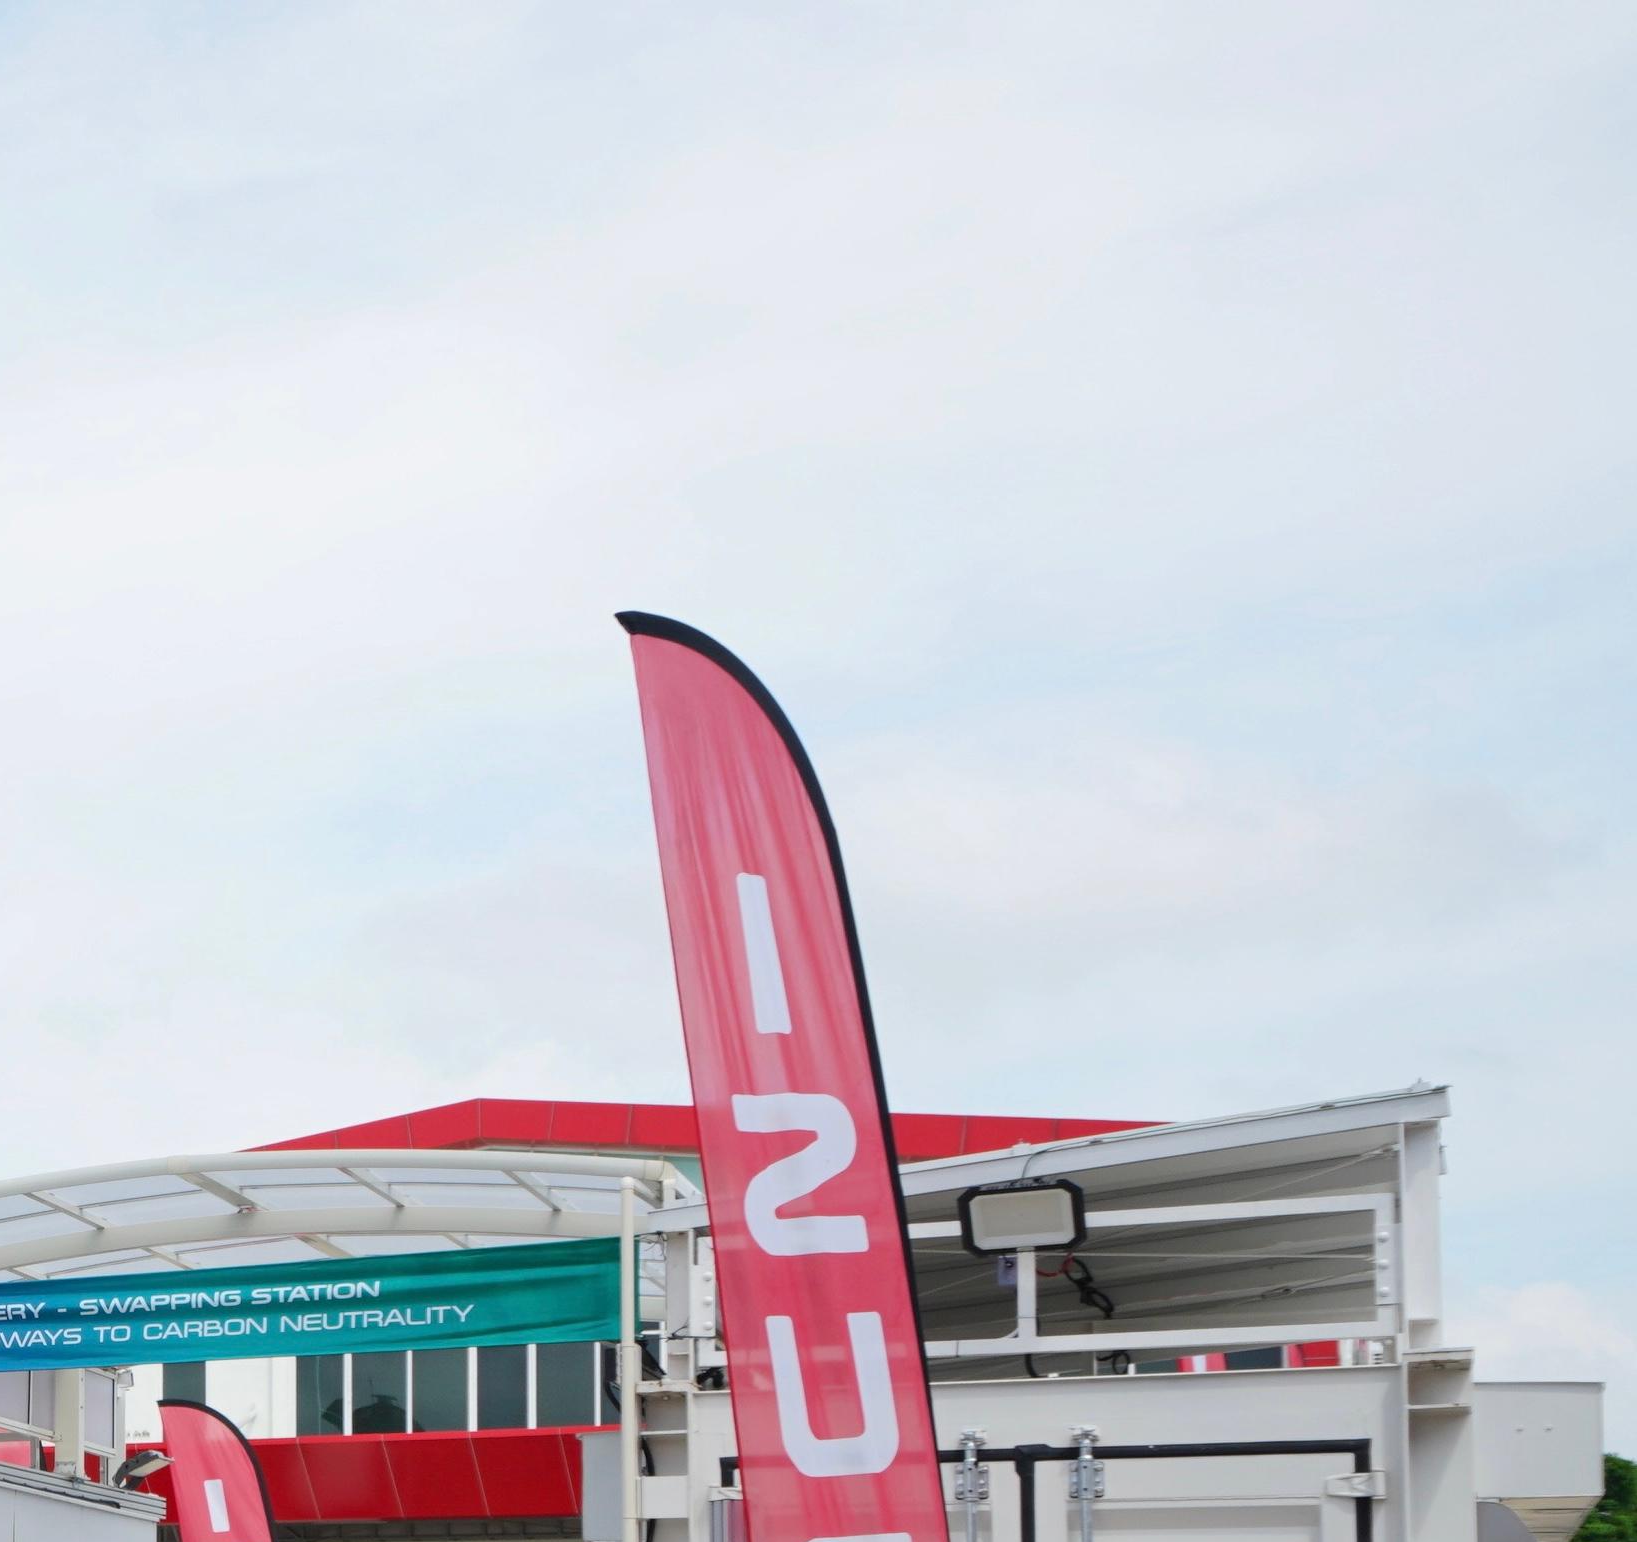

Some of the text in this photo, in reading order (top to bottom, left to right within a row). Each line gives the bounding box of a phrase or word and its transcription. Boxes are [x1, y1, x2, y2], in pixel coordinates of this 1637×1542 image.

[79, 1290, 241, 1316] SWAPPING
[251, 1281, 380, 1304] STATION
[93, 1324, 131, 1343] TO
[142, 1317, 268, 1341] CARBON
[279, 1304, 475, 1333] NEUTRALITY
